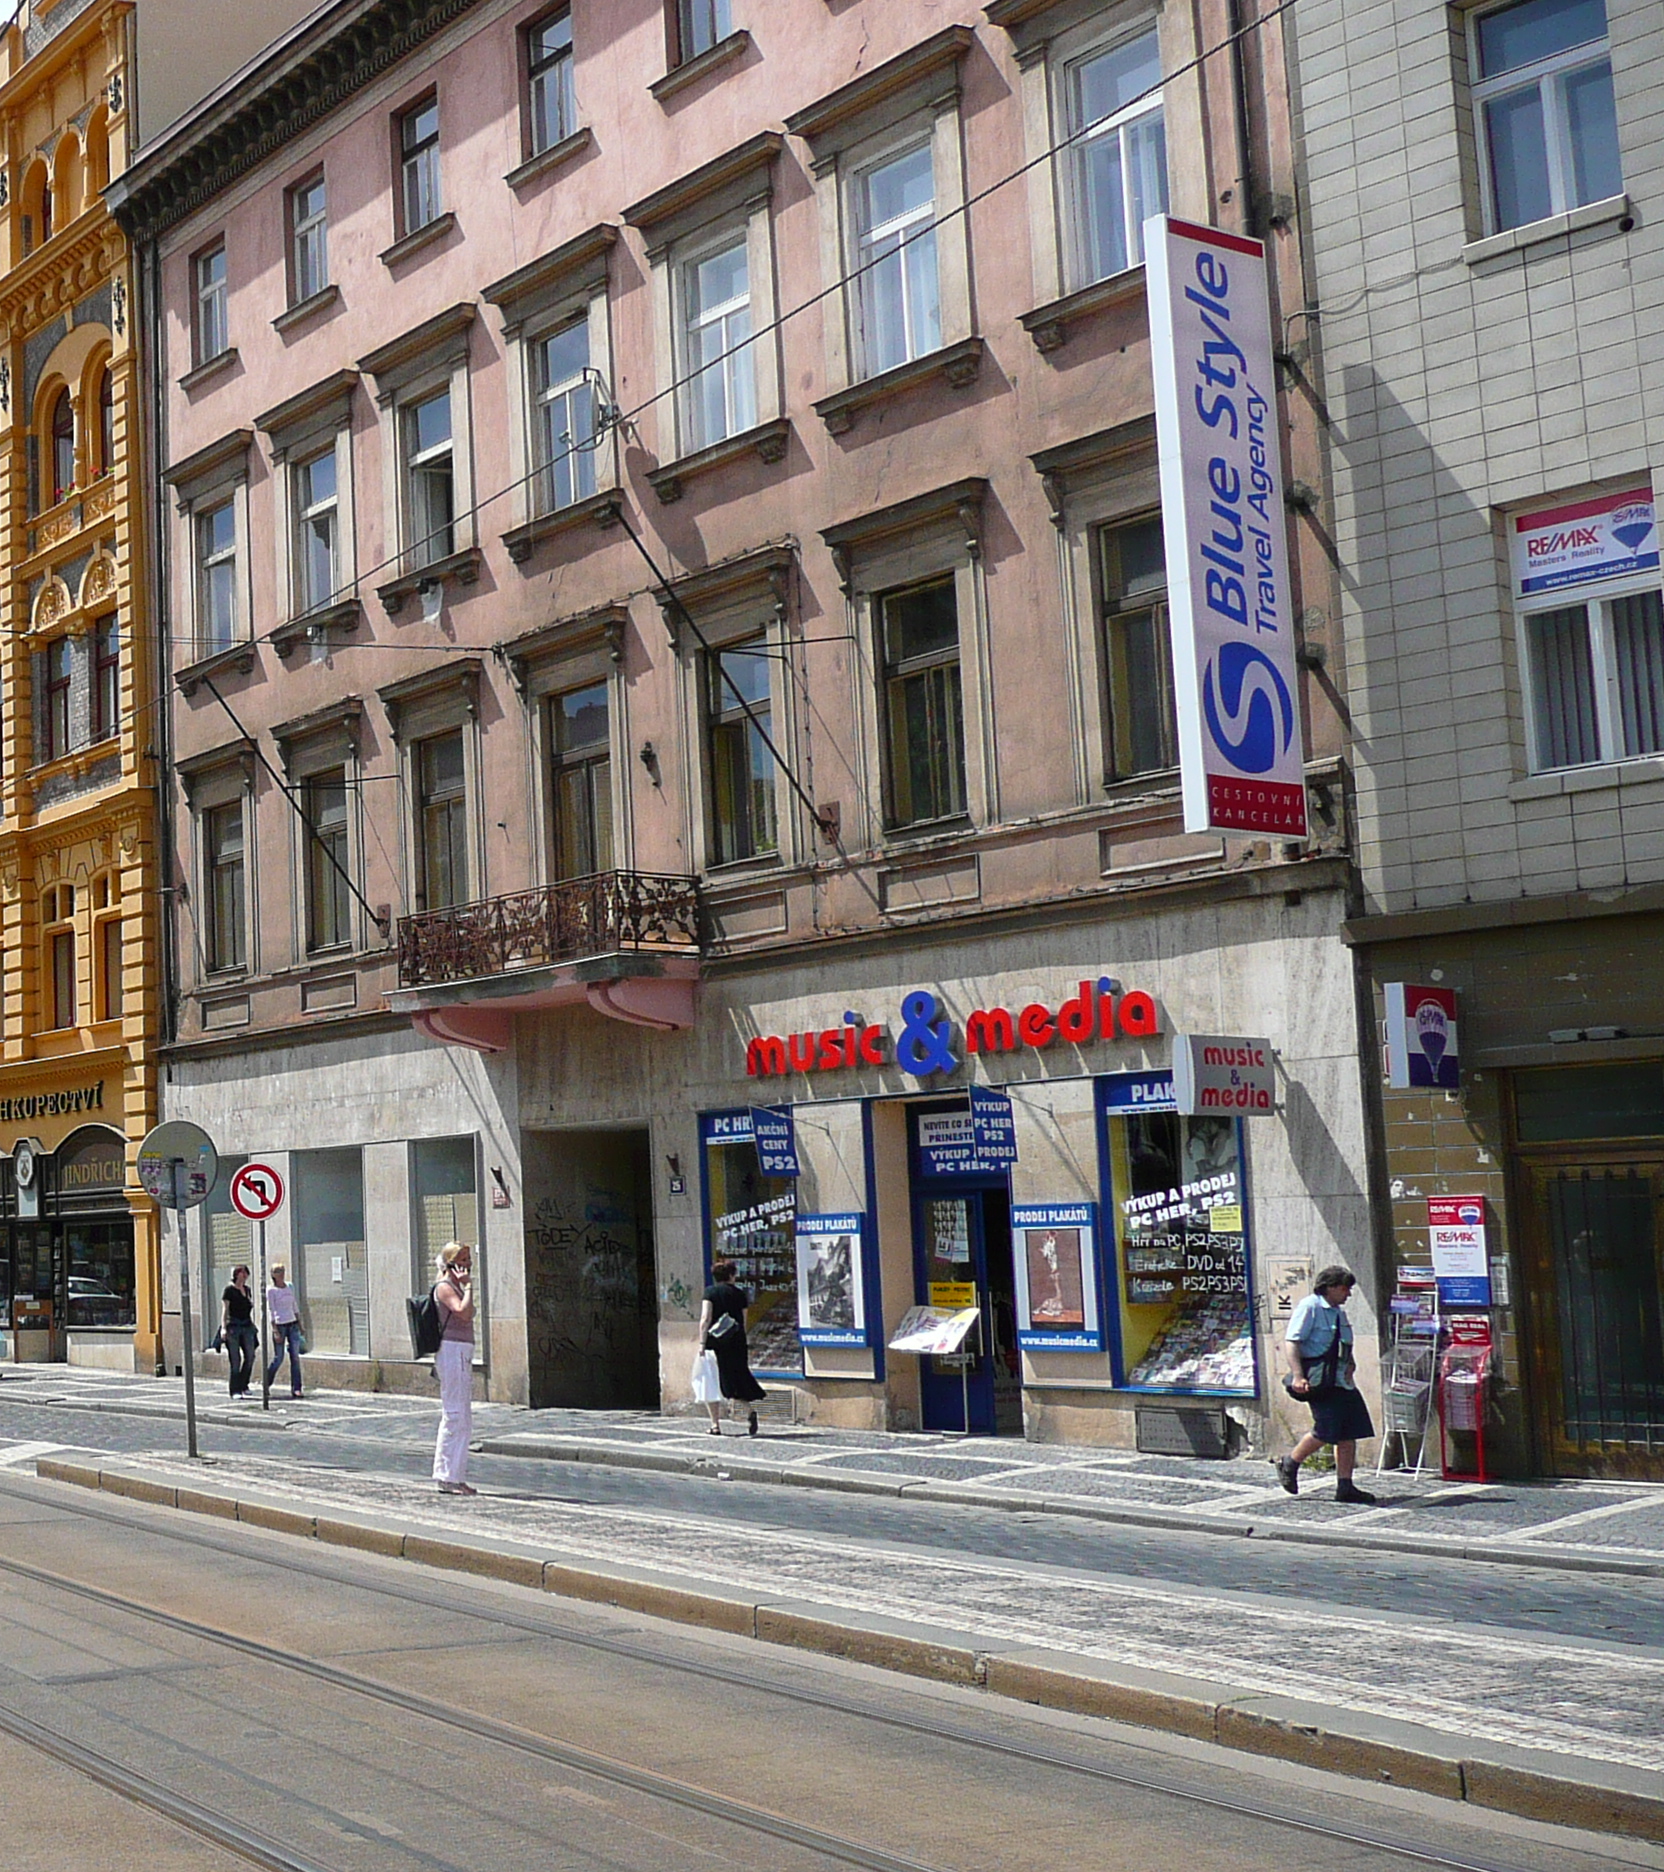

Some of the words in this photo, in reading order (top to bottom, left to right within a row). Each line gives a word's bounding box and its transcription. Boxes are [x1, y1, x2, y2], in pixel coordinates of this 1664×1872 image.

[1184, 250, 1247, 442] Style
[1245, 381, 1274, 522] Agency
[1200, 457, 1249, 626] Blue
[1528, 525, 1599, 558] RE/MAX
[1529, 554, 1566, 569] Masters
[1571, 546, 1605, 560] Reality
[1247, 525, 1278, 635] Travel
[747, 1010, 885, 1076] music
[896, 990, 959, 1077] &
[966, 976, 1159, 1054] media
[1204, 1042, 1265, 1068] music
[1229, 1069, 1242, 1086] &
[1201, 1082, 1270, 1108] media
[974, 1098, 1010, 1112] VÝKUP
[714, 1117, 730, 1133] PC
[757, 1122, 789, 1136] AKČNÍ
[975, 1118, 988, 1128] PC
[990, 1118, 1013, 1128] HER
[983, 1130, 1005, 1140] PS2
[762, 1139, 788, 1150] CENY
[977, 1146, 1015, 1157] PRODEJ
[929, 1147, 970, 1161] VÝKUP
[762, 1156, 796, 1170] PS2
[936, 1162, 954, 1172] PC
[1121, 1195, 1165, 1214] VÝKUP
[1169, 1188, 1181, 1202] A
[1181, 1172, 1236, 1198] PRODEJ
[716, 1210, 747, 1229] VÝKUP
[749, 1206, 757, 1219] A
[758, 1193, 795, 1216] PRODEJ
[1014, 1210, 1047, 1222] PRODEJ
[1048, 1206, 1088, 1221] PLAKÁTŮ
[1130, 1215, 1152, 1229] PC
[1201, 1191, 1236, 1210] PS2
[722, 1227, 738, 1240] PC
[771, 1209, 795, 1226] PS2
[796, 1219, 823, 1231] PRODEJ
[825, 1215, 857, 1230] PLAKÁTŮ
[1187, 1254, 1214, 1270] DVD
[1020, 1335, 1099, 1347] www.musicmedia.cz
